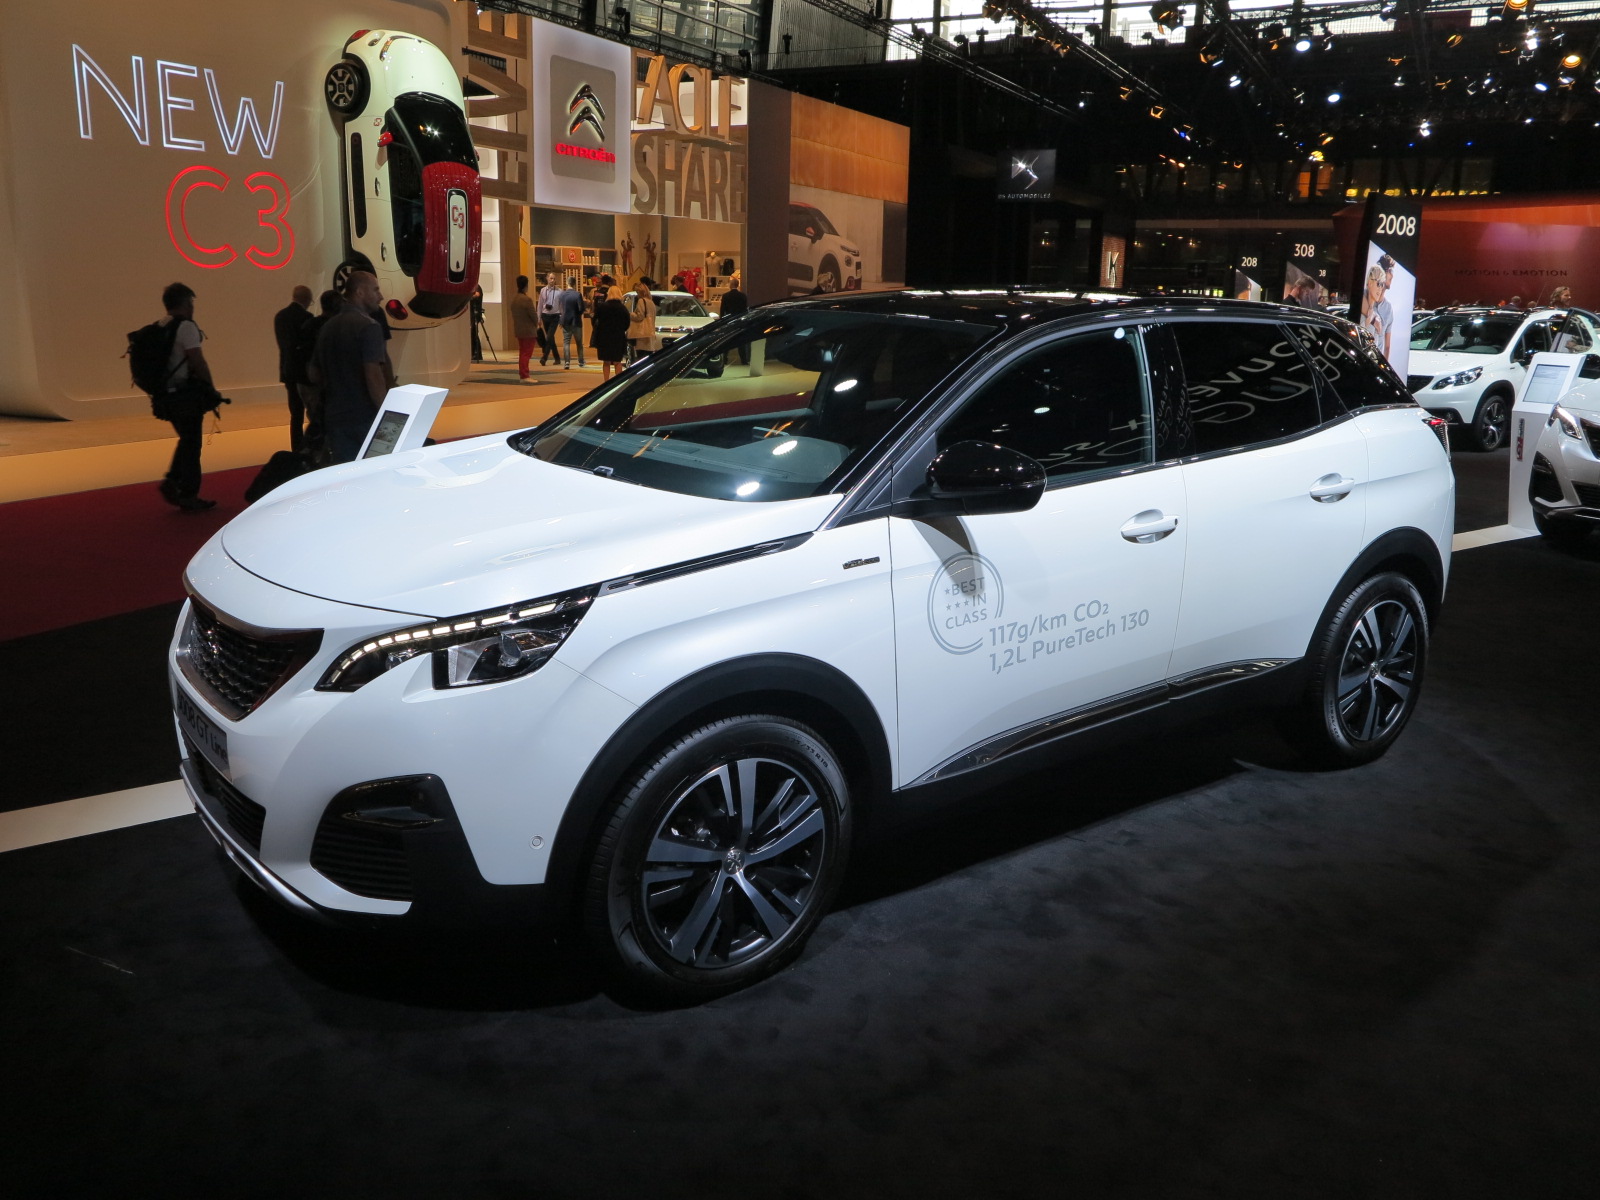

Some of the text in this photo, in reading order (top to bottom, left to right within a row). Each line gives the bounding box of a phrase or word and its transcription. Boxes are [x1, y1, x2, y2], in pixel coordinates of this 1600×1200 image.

[72, 43, 284, 159] NEW
[165, 165, 295, 270] C3
[1376, 213, 1417, 237] 2008
[1241, 256, 1258, 267] 208
[1293, 243, 1315, 258] 308
[1512, 269, 1568, 277] EMOTION
[951, 577, 985, 596] BEST
[972, 593, 987, 607] IN
[945, 608, 988, 630] CLASS
[989, 612, 1067, 647] 117g/km
[989, 609, 1150, 675] 1,2L PureTech 130
